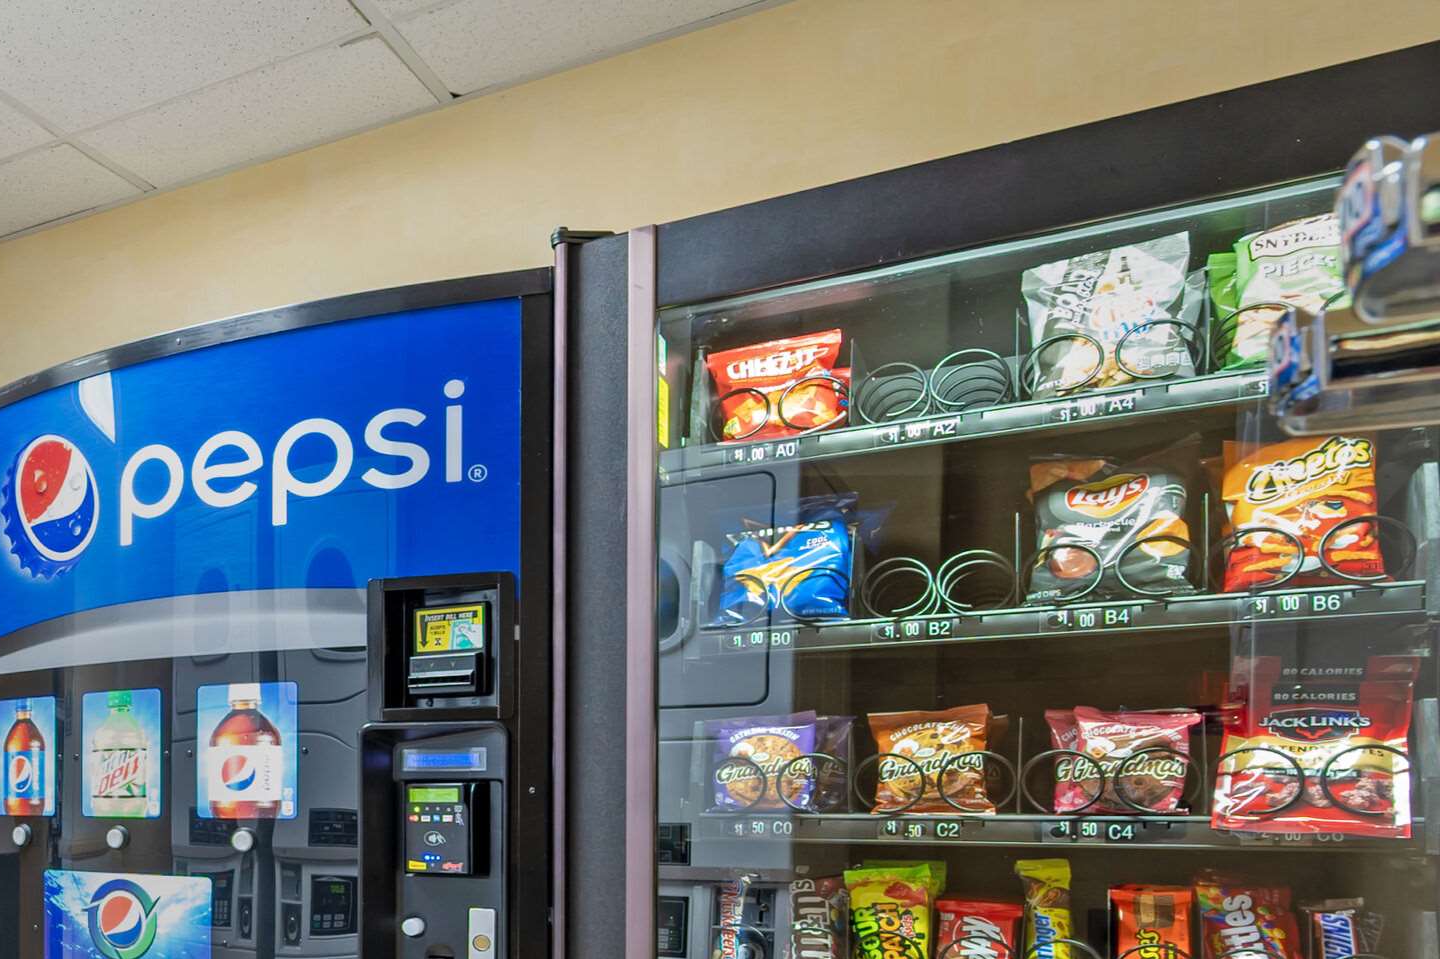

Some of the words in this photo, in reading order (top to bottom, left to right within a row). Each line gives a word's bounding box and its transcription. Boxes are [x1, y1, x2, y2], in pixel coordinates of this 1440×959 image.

[1109, 399, 1134, 412] A4
[934, 422, 956, 435] A2
[775, 443, 795, 458] A0
[120, 379, 466, 546] pepsi
[1313, 595, 1341, 611] B6
[1105, 609, 1129, 625] B4
[929, 622, 950, 636] B2
[771, 632, 791, 646] B0
[1300, 667, 1364, 676] CALORIES
[1292, 692, 1356, 701] CALORIES
[1258, 717, 1309, 727] JACK
[773, 821, 792, 834] C0
[936, 823, 959, 837] C2
[1108, 824, 1134, 840] C4
